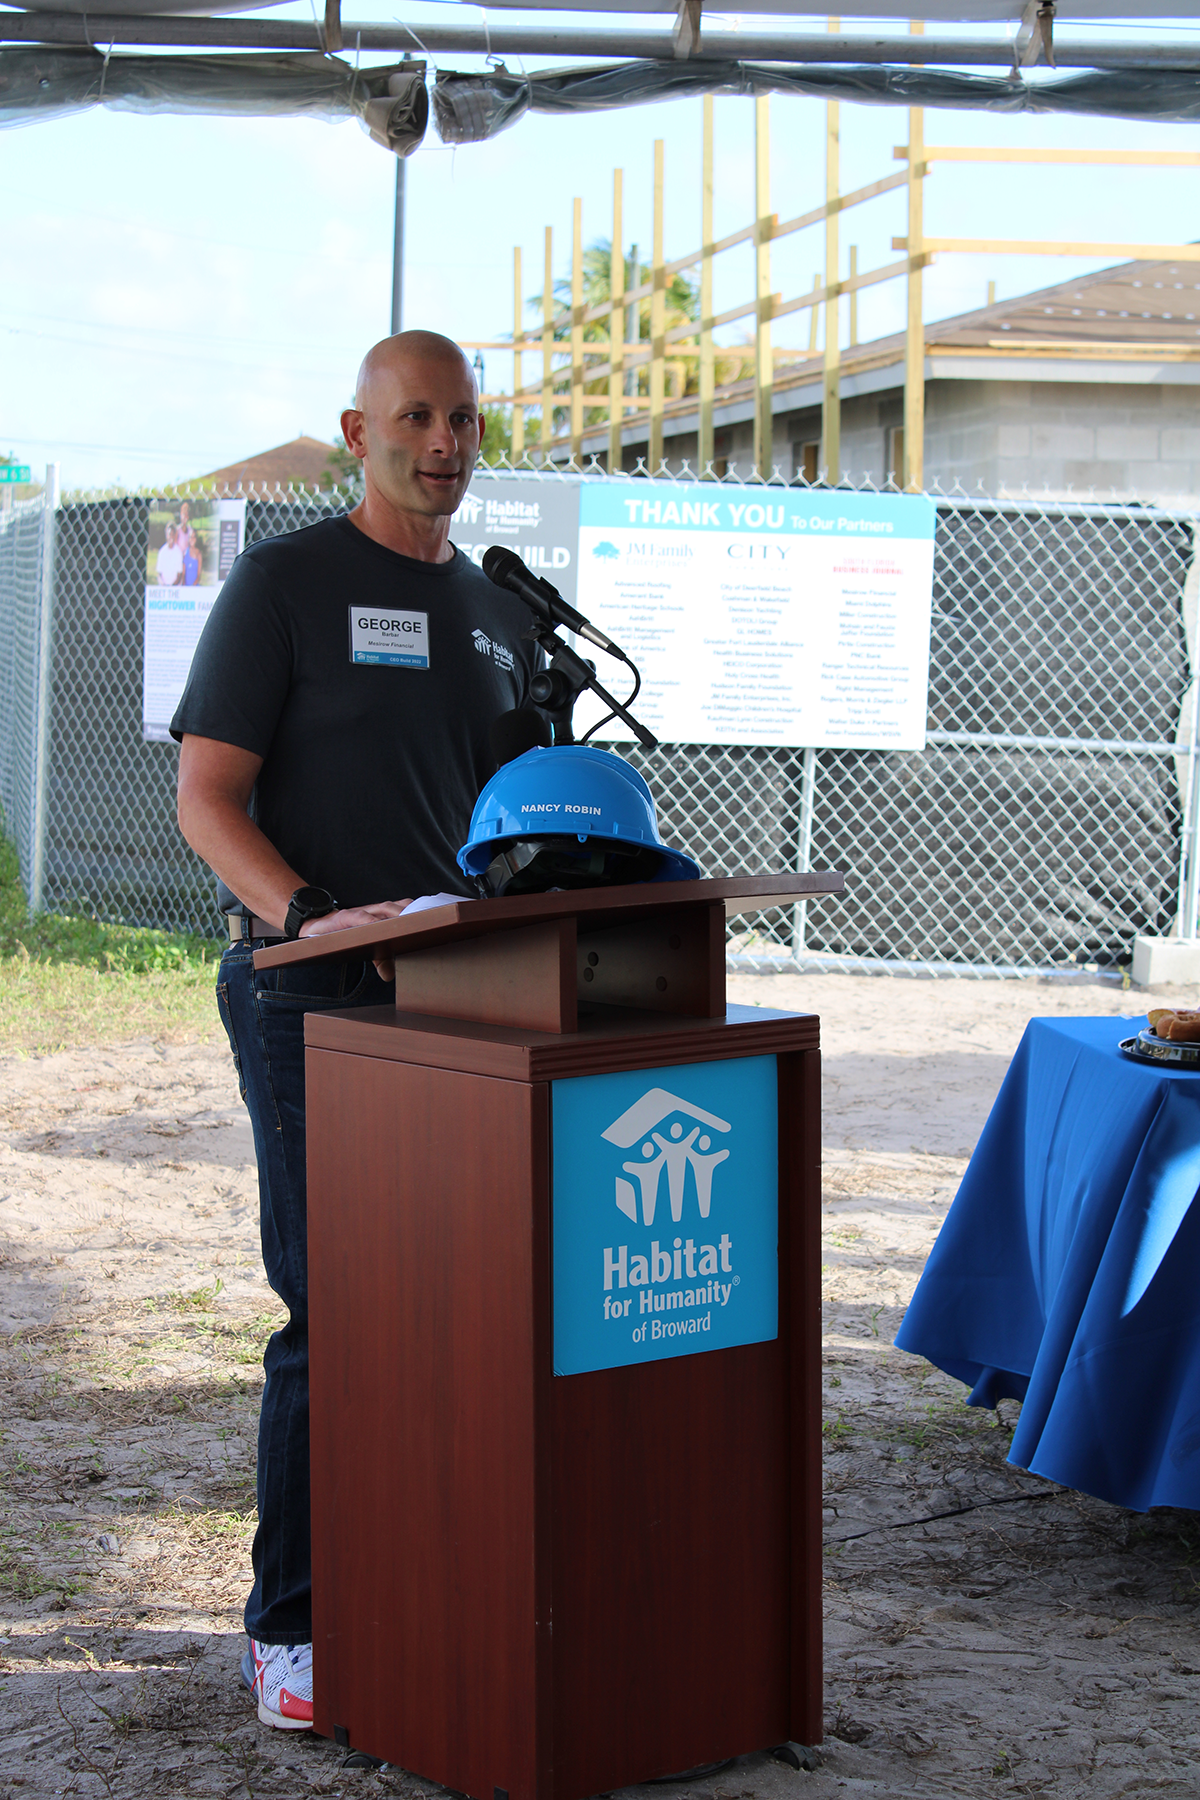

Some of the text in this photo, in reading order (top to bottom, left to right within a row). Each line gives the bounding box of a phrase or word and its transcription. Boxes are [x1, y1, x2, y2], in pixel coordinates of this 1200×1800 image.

[485, 500, 540, 517] Habitat
[624, 500, 894, 532] THANK YOU To Our Partners
[485, 516, 498, 525] for
[727, 543, 791, 560] CITY
[148, 600, 214, 611] HIGHTOWER FAM
[358, 618, 422, 633] GEORGE
[492, 641, 513, 662] Habitat
[521, 804, 601, 815] NANCY ROBIN
[603, 1234, 732, 1291] Habitat
[603, 1280, 732, 1320] for Humanity
[632, 1312, 711, 1343] of Broward
